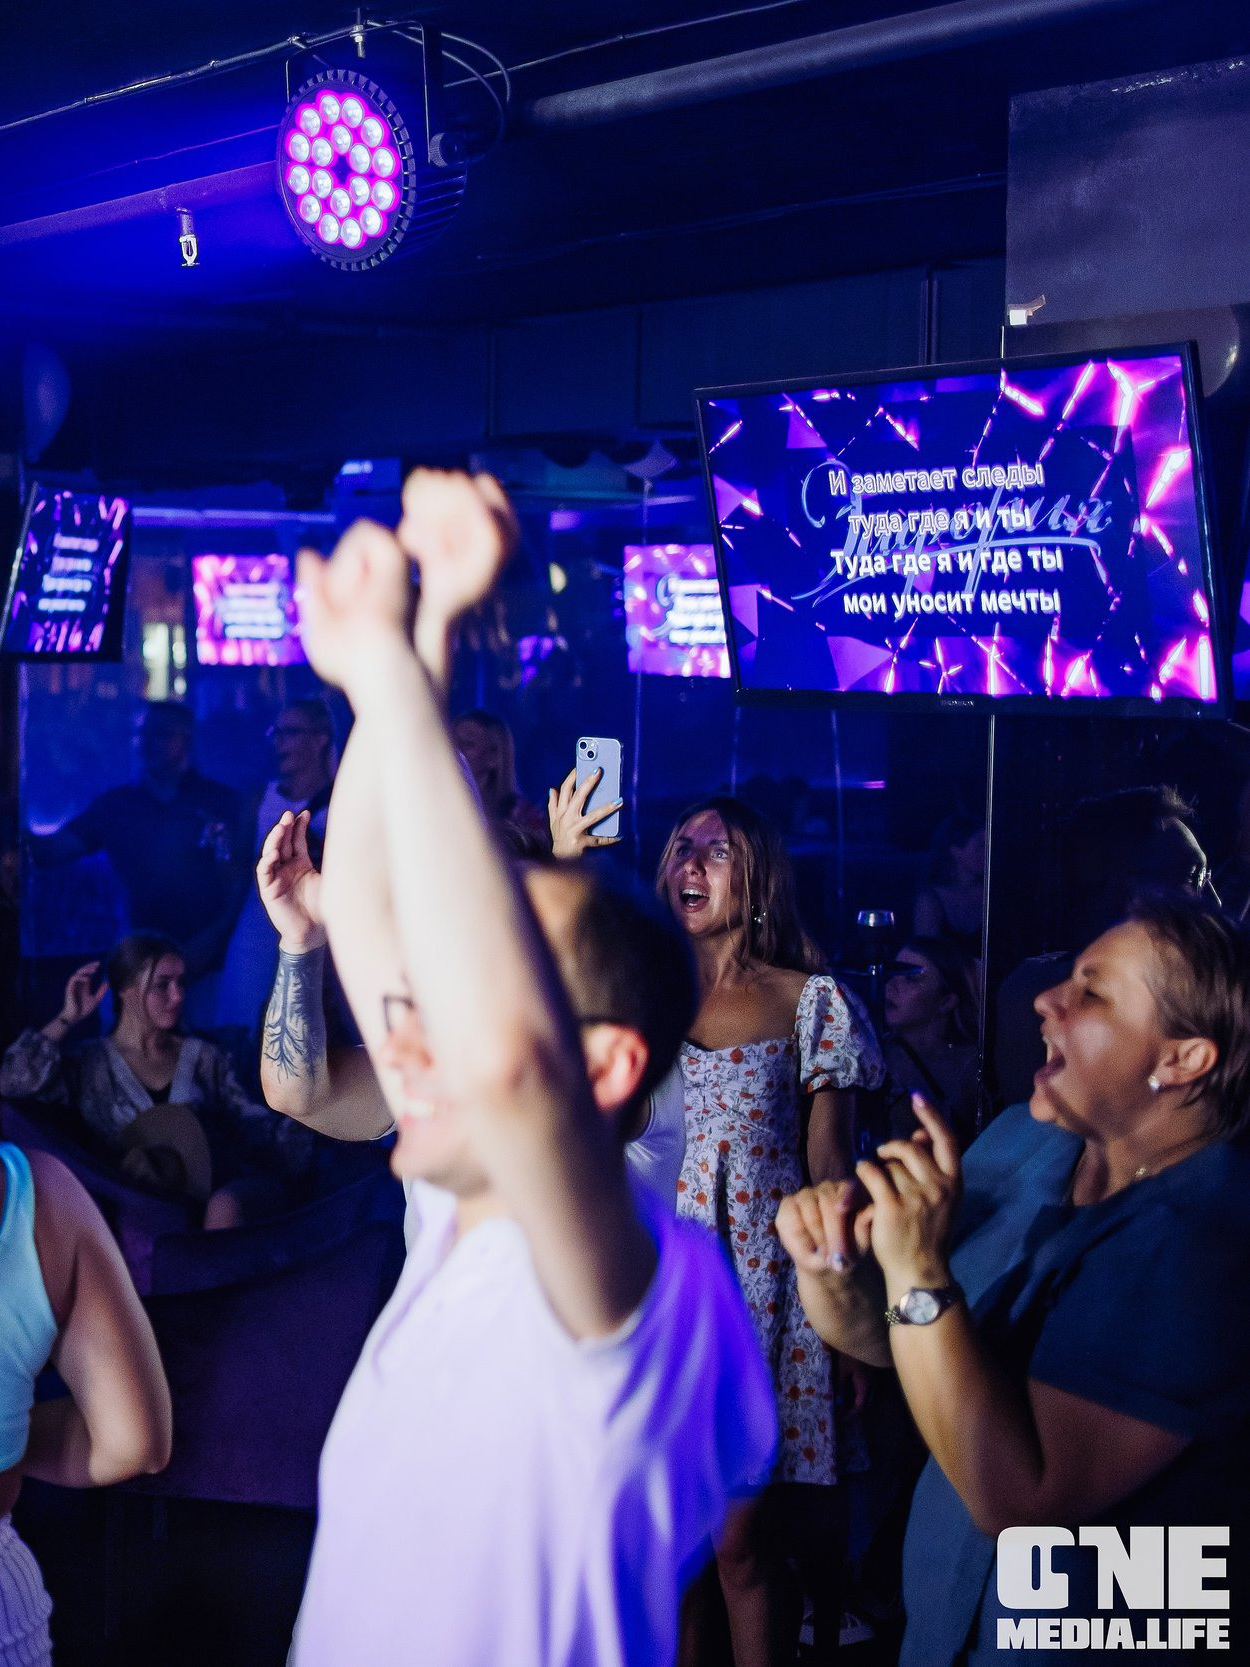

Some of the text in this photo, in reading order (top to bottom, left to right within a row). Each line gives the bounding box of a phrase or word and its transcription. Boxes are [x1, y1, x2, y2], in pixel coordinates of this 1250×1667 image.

[828, 461, 1046, 496] И заметает следы
[848, 505, 1032, 539] туда где я и ты
[830, 546, 1064, 579] Туда где я и где ты
[843, 588, 1062, 618] мои уносит мечты
